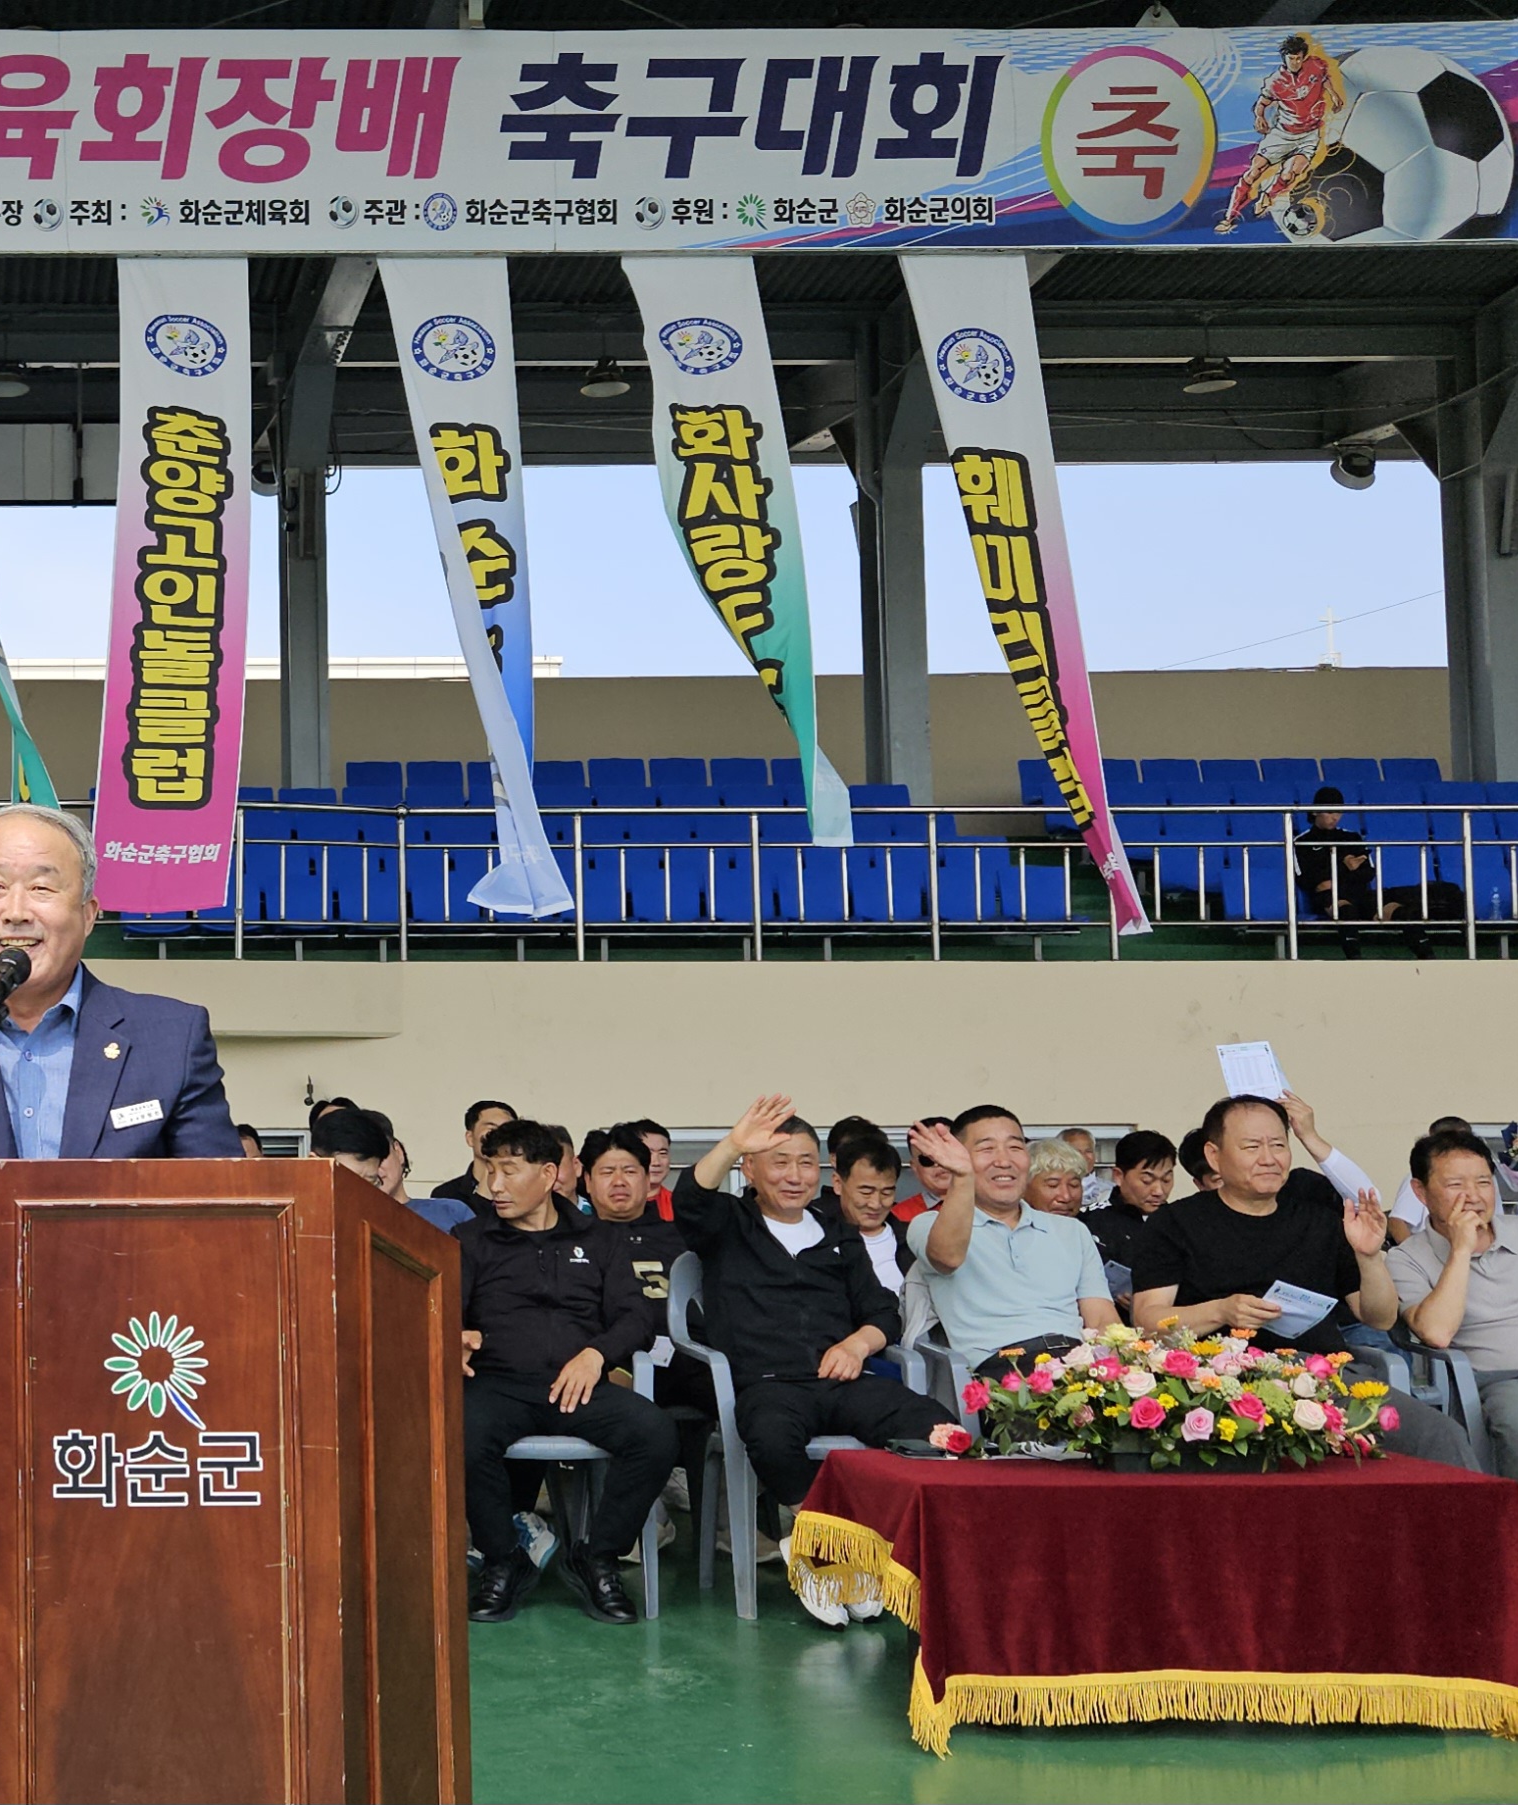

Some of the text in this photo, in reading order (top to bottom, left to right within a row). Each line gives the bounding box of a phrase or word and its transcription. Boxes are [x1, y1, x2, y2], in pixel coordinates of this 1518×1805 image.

[499, 51, 1006, 179] 축구대회
[1074, 84, 1181, 200] 축
[69, 199, 112, 226] 주최
[179, 198, 311, 226] 화순군체육회
[363, 199, 407, 226] 주관
[465, 198, 618, 226] 화순군축구협회
[671, 197, 714, 225] 후원
[773, 197, 839, 225] 화순군
[884, 196, 995, 223] 화순군의회
[128, 406, 234, 811] 춘양고인돌클럽
[102, 839, 222, 864] 화순군축구협회
[632, 1261, 669, 1299] 5
[52, 1429, 264, 1508] 화순군
